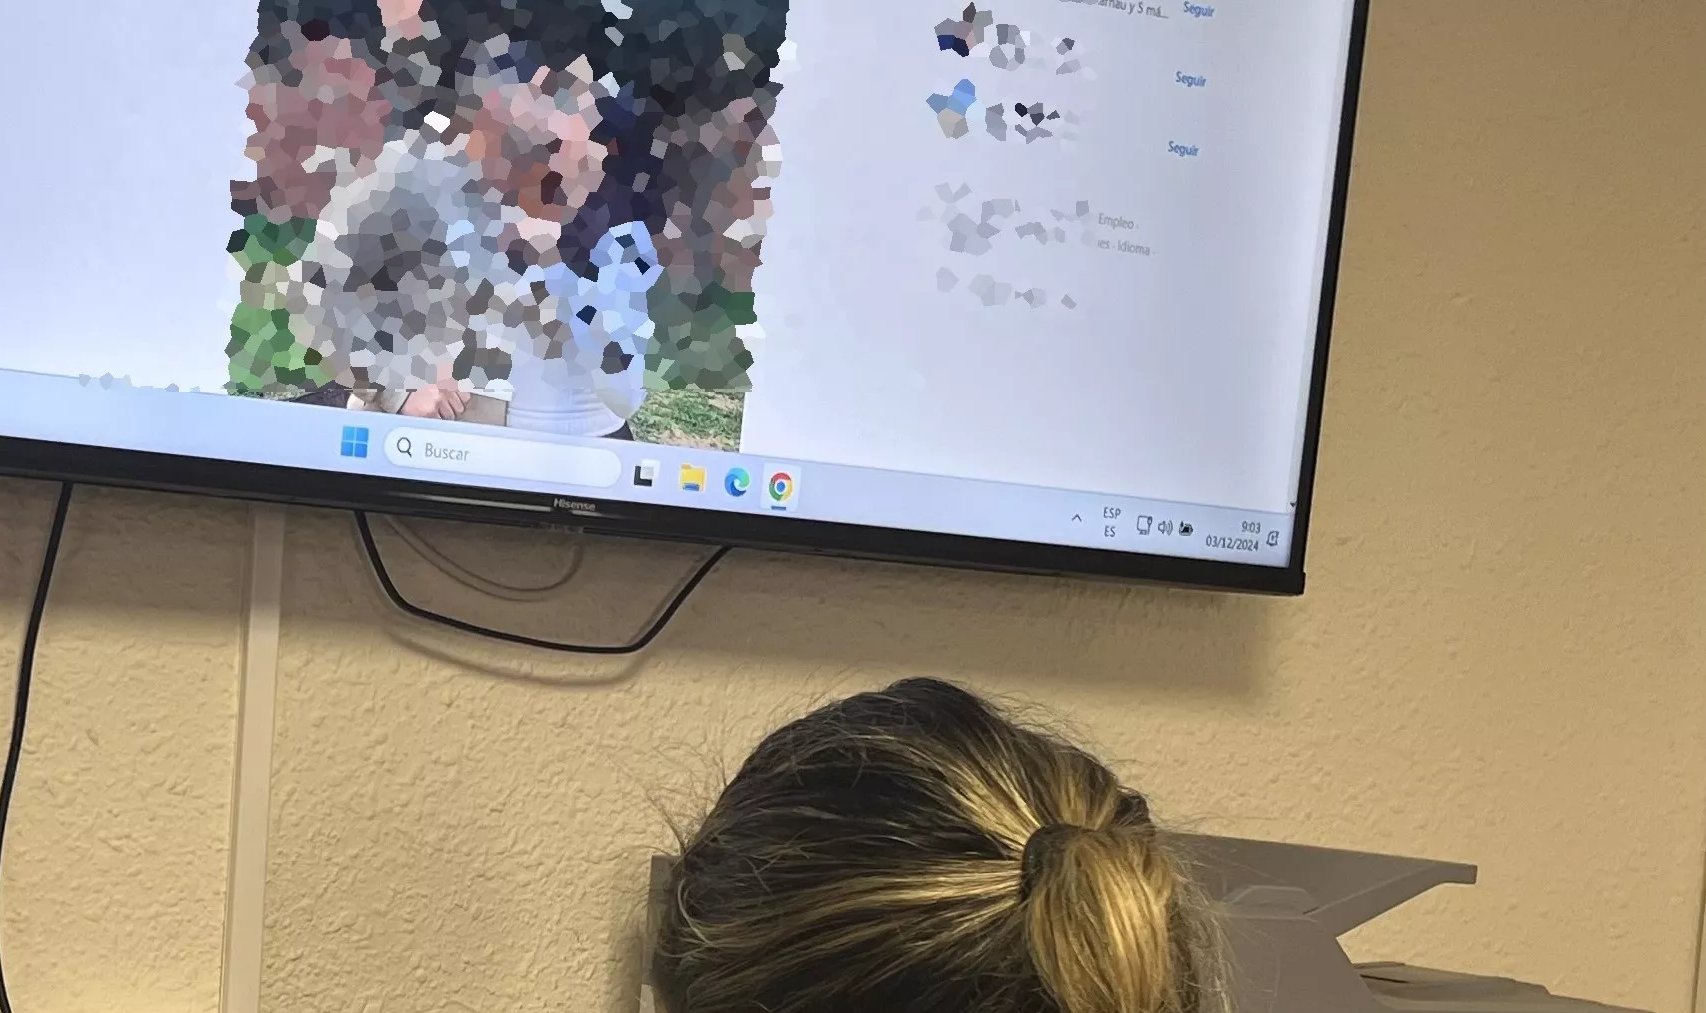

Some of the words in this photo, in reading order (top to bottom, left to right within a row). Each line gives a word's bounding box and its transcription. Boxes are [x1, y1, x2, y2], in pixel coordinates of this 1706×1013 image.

[1183, 1, 1214, 18] Seguir
[1175, 70, 1207, 88] Seguir
[1167, 140, 1199, 157] Seguir
[1098, 213, 1135, 230] Empleo
[1117, 239, 1151, 256] Idioma
[424, 441, 470, 462] Buscar
[553, 497, 596, 511] Hisense
[1103, 506, 1122, 519] ESP
[1103, 525, 1116, 538] ES
[1241, 520, 1262, 534] 9:03
[1205, 533, 1260, 552] 03/12/2024
